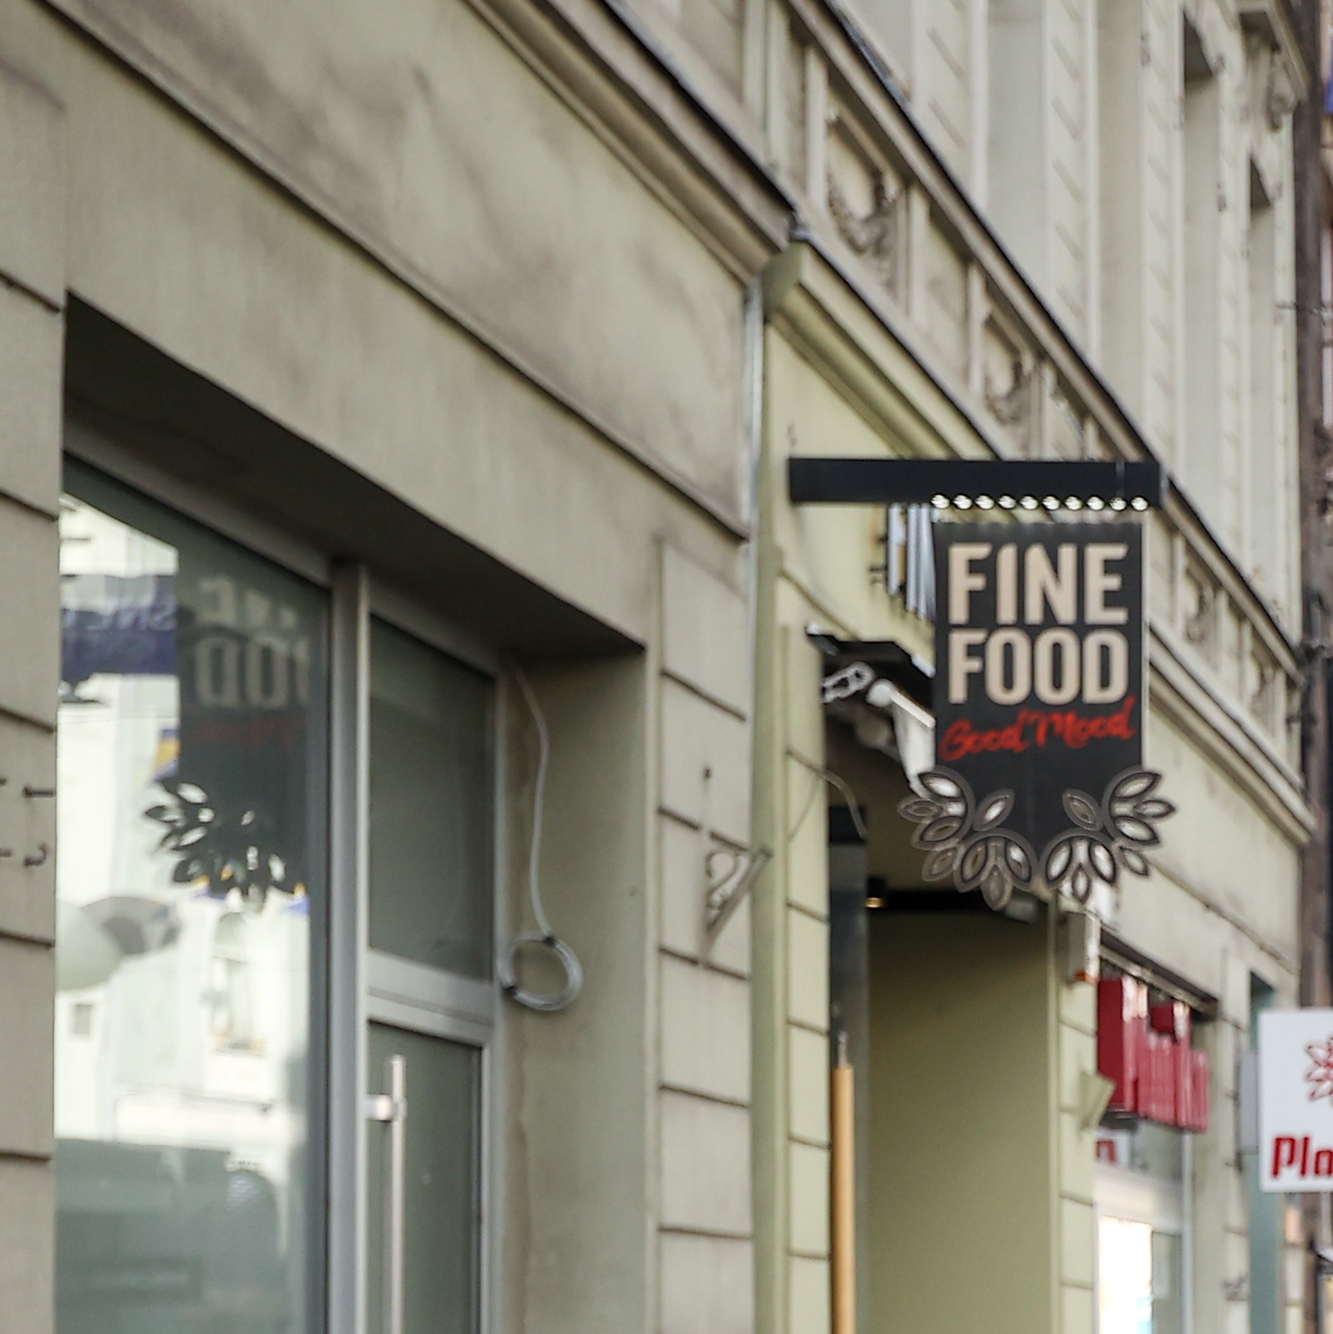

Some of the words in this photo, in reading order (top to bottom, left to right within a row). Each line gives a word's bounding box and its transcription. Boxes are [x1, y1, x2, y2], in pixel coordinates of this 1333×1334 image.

[948, 542, 1129, 625] FINE
[948, 627, 1129, 705] FOOD
[940, 708, 1028, 761] Good
[1028, 695, 1136, 748] Mood
